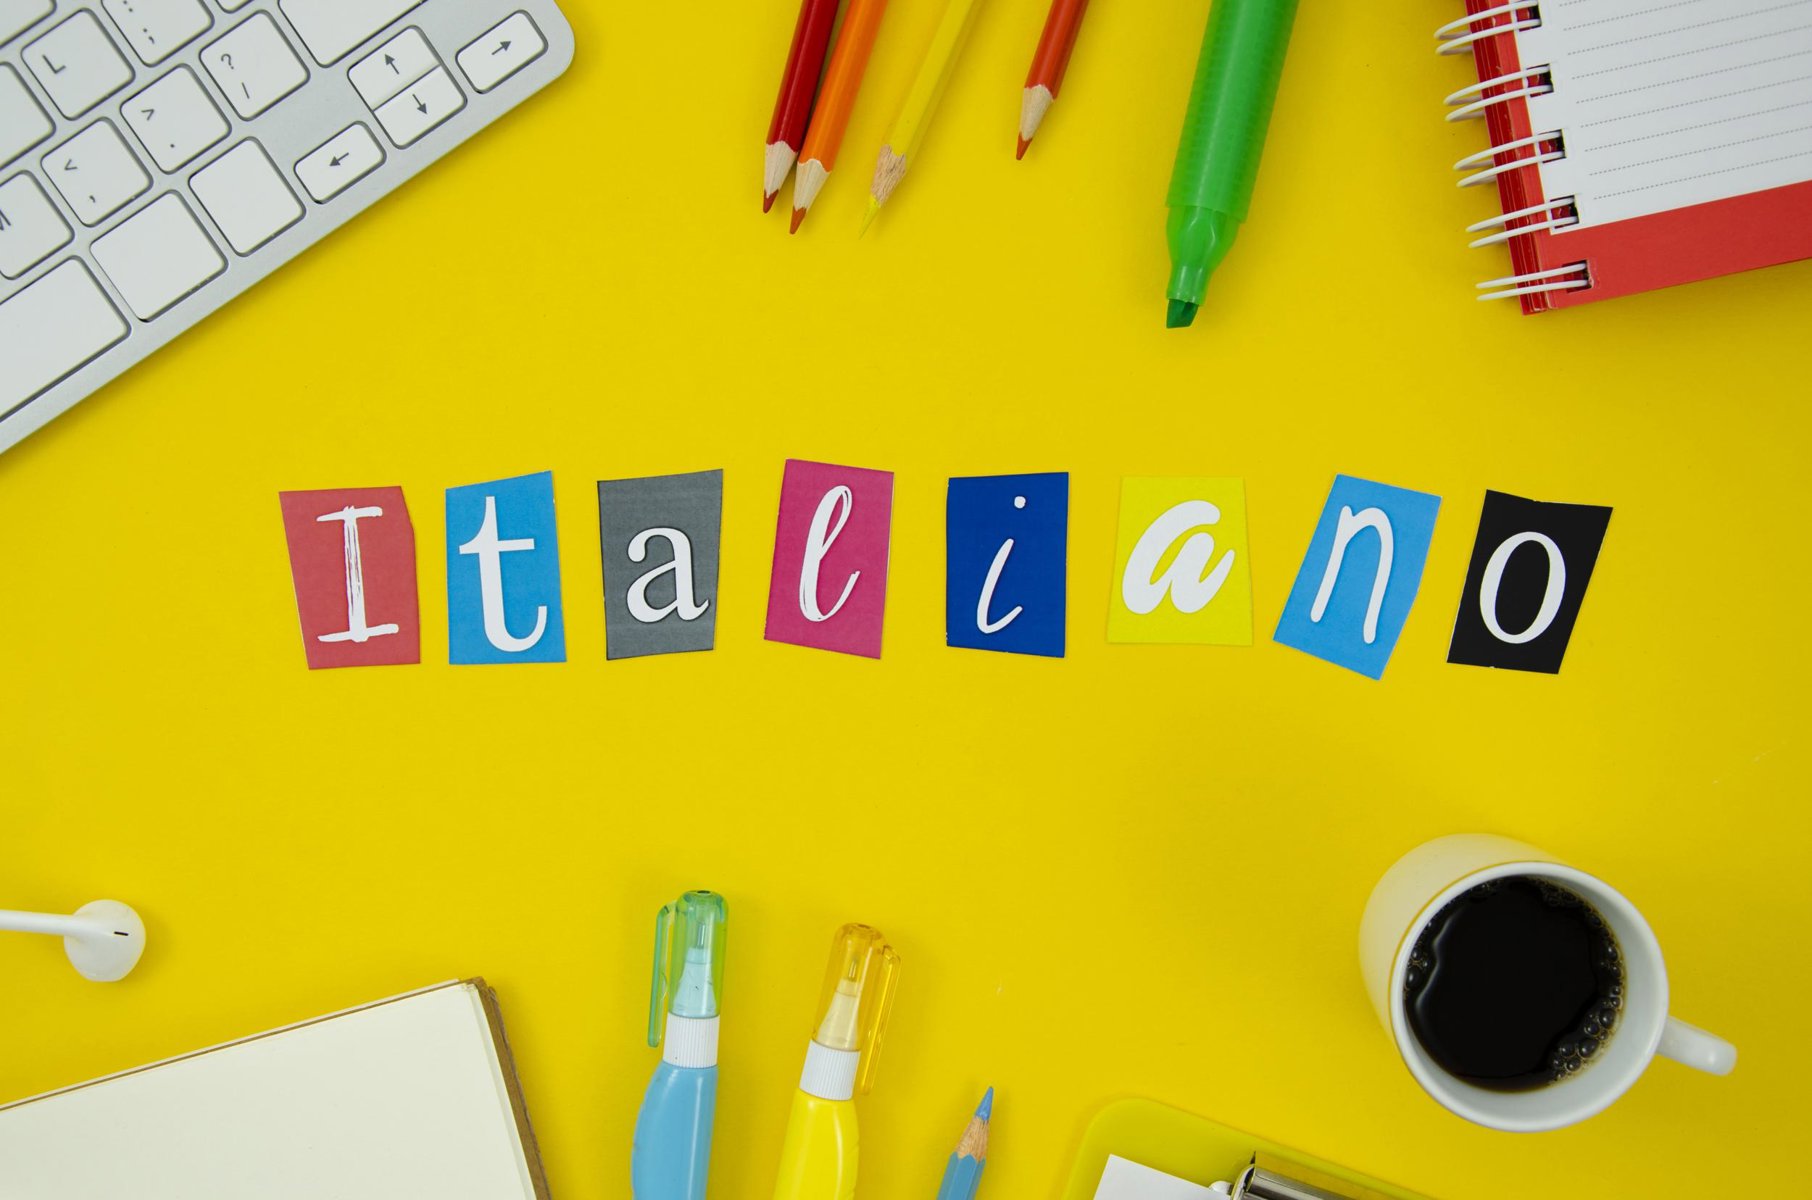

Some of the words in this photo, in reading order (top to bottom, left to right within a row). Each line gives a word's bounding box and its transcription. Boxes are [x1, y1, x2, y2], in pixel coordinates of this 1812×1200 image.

[42, 54, 66, 74] L
[220, 53, 235, 70] ?
[316, 485, 1566, 652] Italiano
